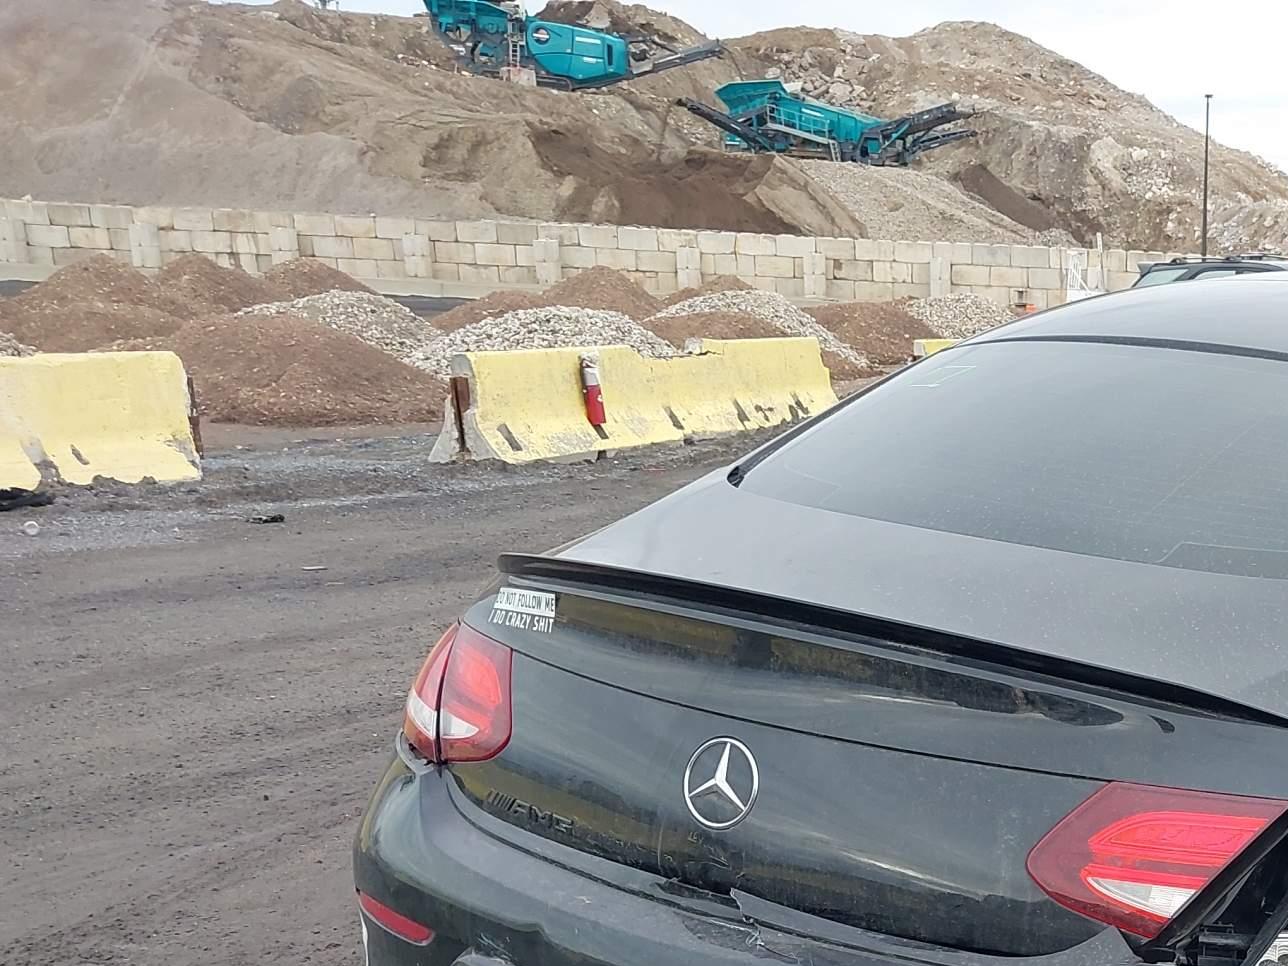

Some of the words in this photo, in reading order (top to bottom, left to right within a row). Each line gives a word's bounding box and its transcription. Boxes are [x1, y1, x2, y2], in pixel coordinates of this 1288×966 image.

[505, 592, 517, 606] NOT
[517, 593, 542, 610] FOLLOW
[544, 597, 554, 612] ME
[488, 609, 495, 622] I
[493, 610, 506, 624] DO
[506, 611, 531, 629] CRAZY
[532, 616, 554, 633] SHIT
